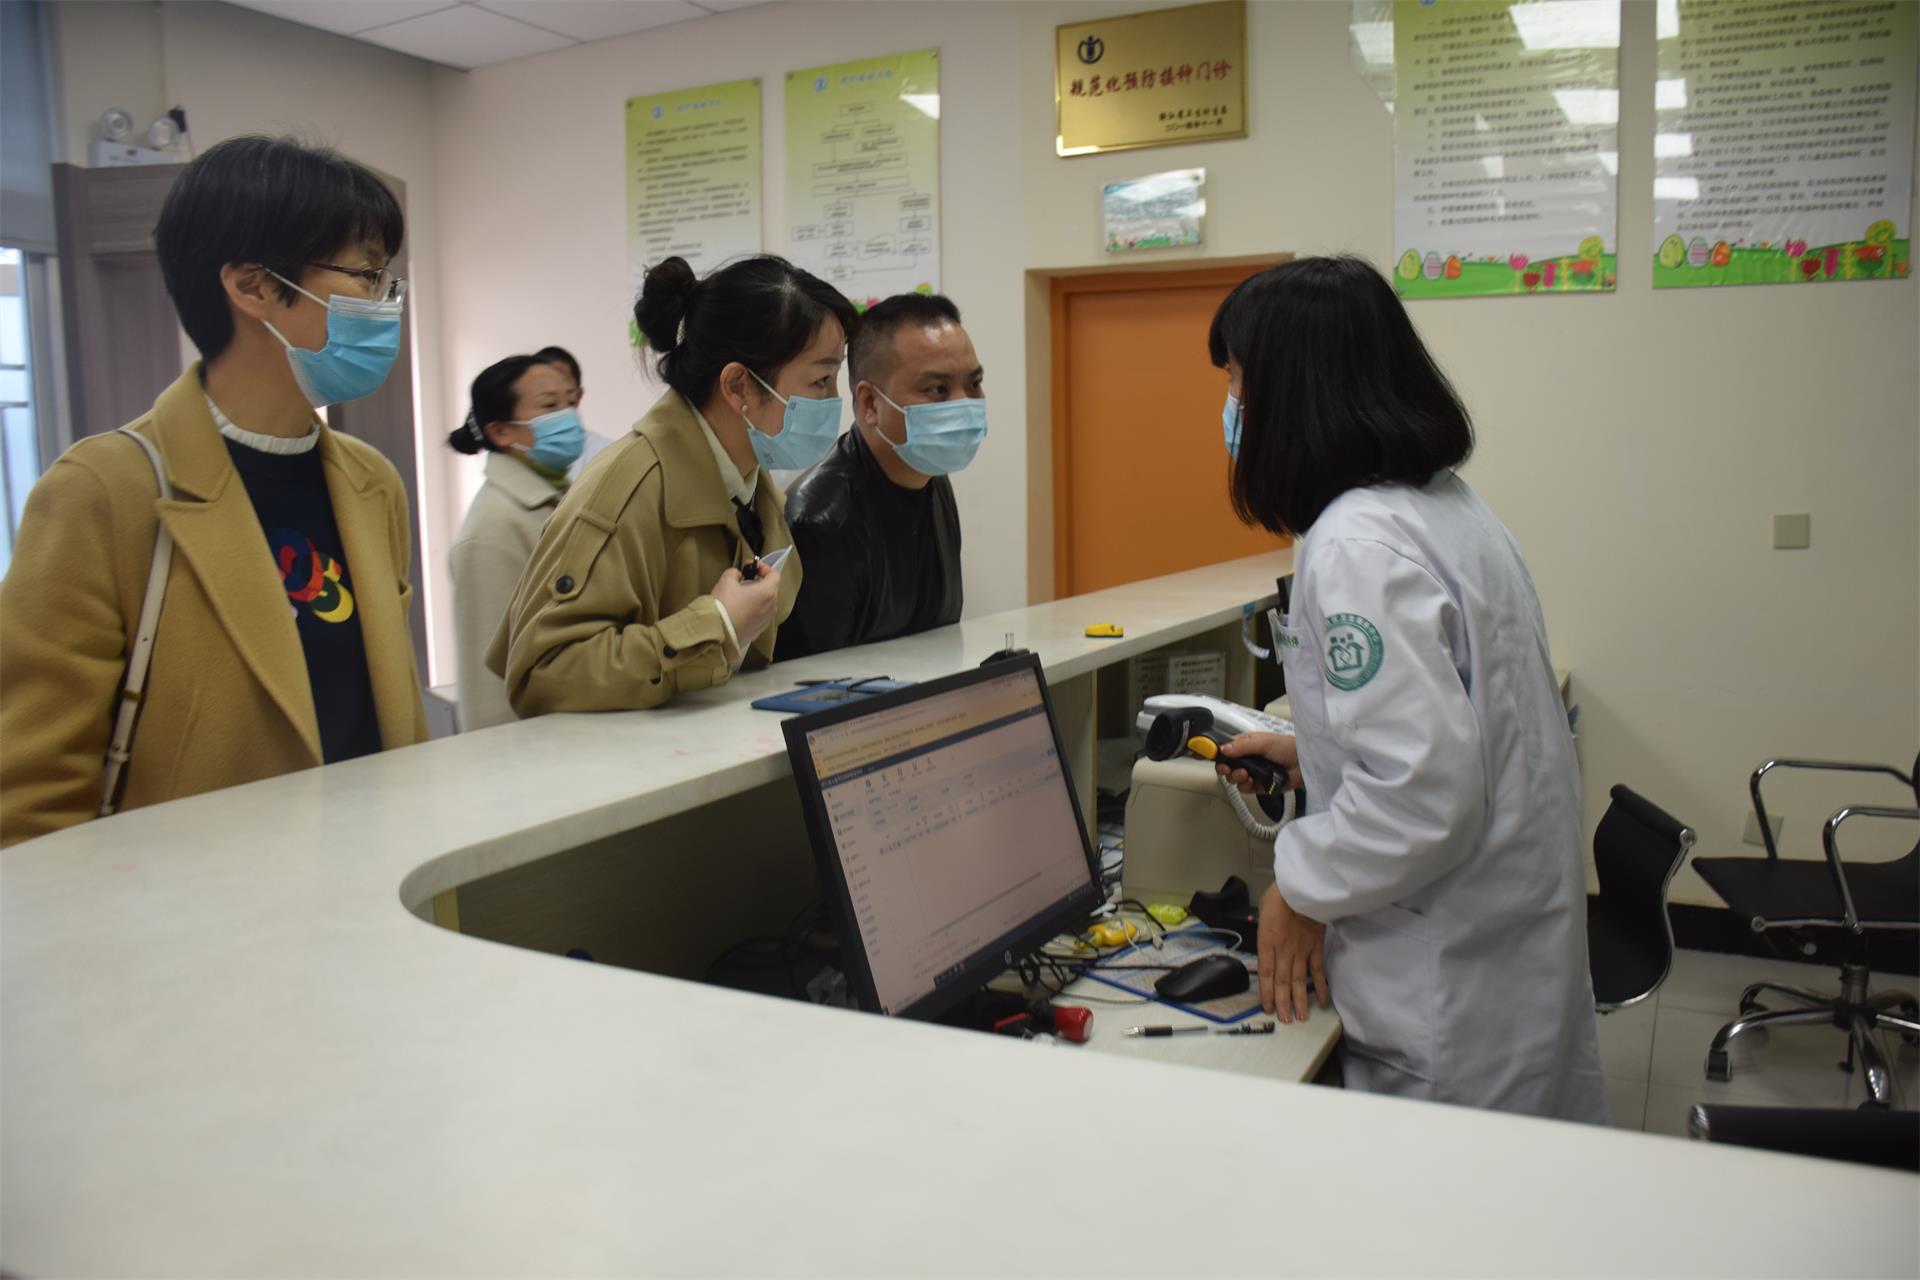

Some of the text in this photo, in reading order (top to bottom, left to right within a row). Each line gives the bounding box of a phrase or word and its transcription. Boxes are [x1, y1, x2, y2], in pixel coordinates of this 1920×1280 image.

[1070, 60, 1232, 97] 规范化预防接种门诊
